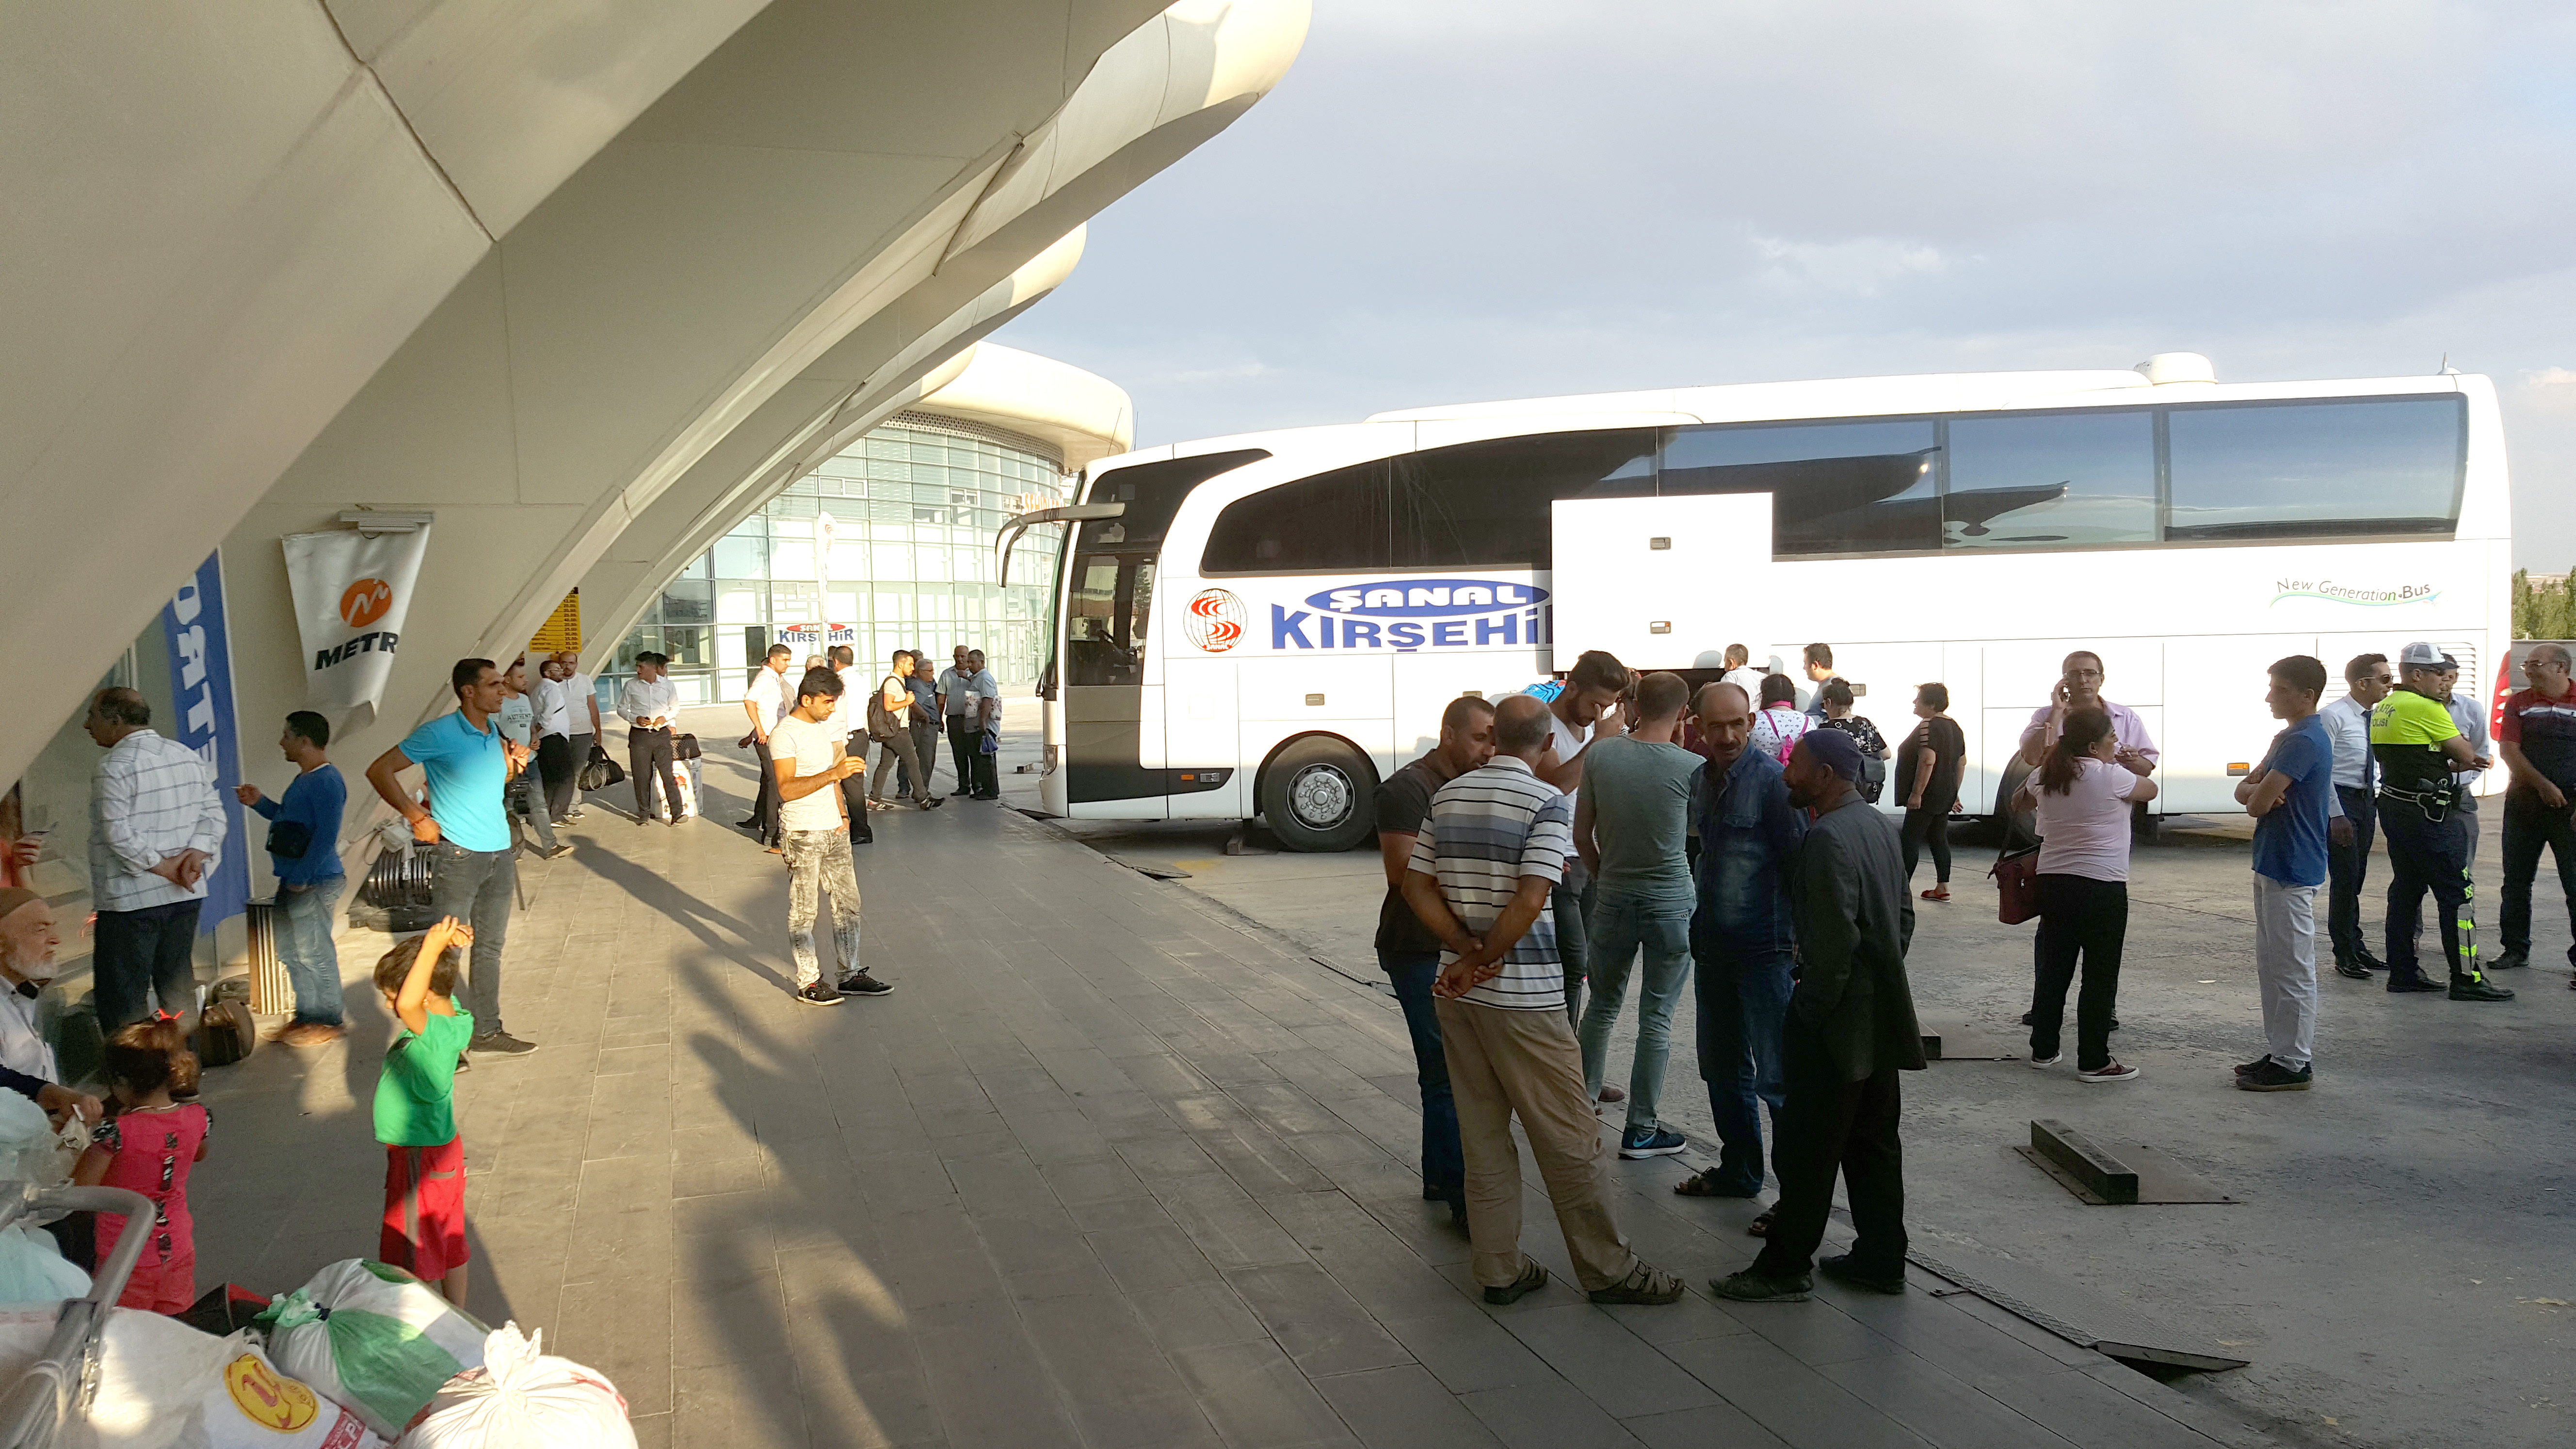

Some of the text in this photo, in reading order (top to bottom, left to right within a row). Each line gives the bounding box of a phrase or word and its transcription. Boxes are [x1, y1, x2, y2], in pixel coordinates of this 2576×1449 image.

[1329, 585, 1527, 612] ŞANAL
[2277, 578, 2431, 601] New Generation Bus
[314, 631, 399, 671] METR
